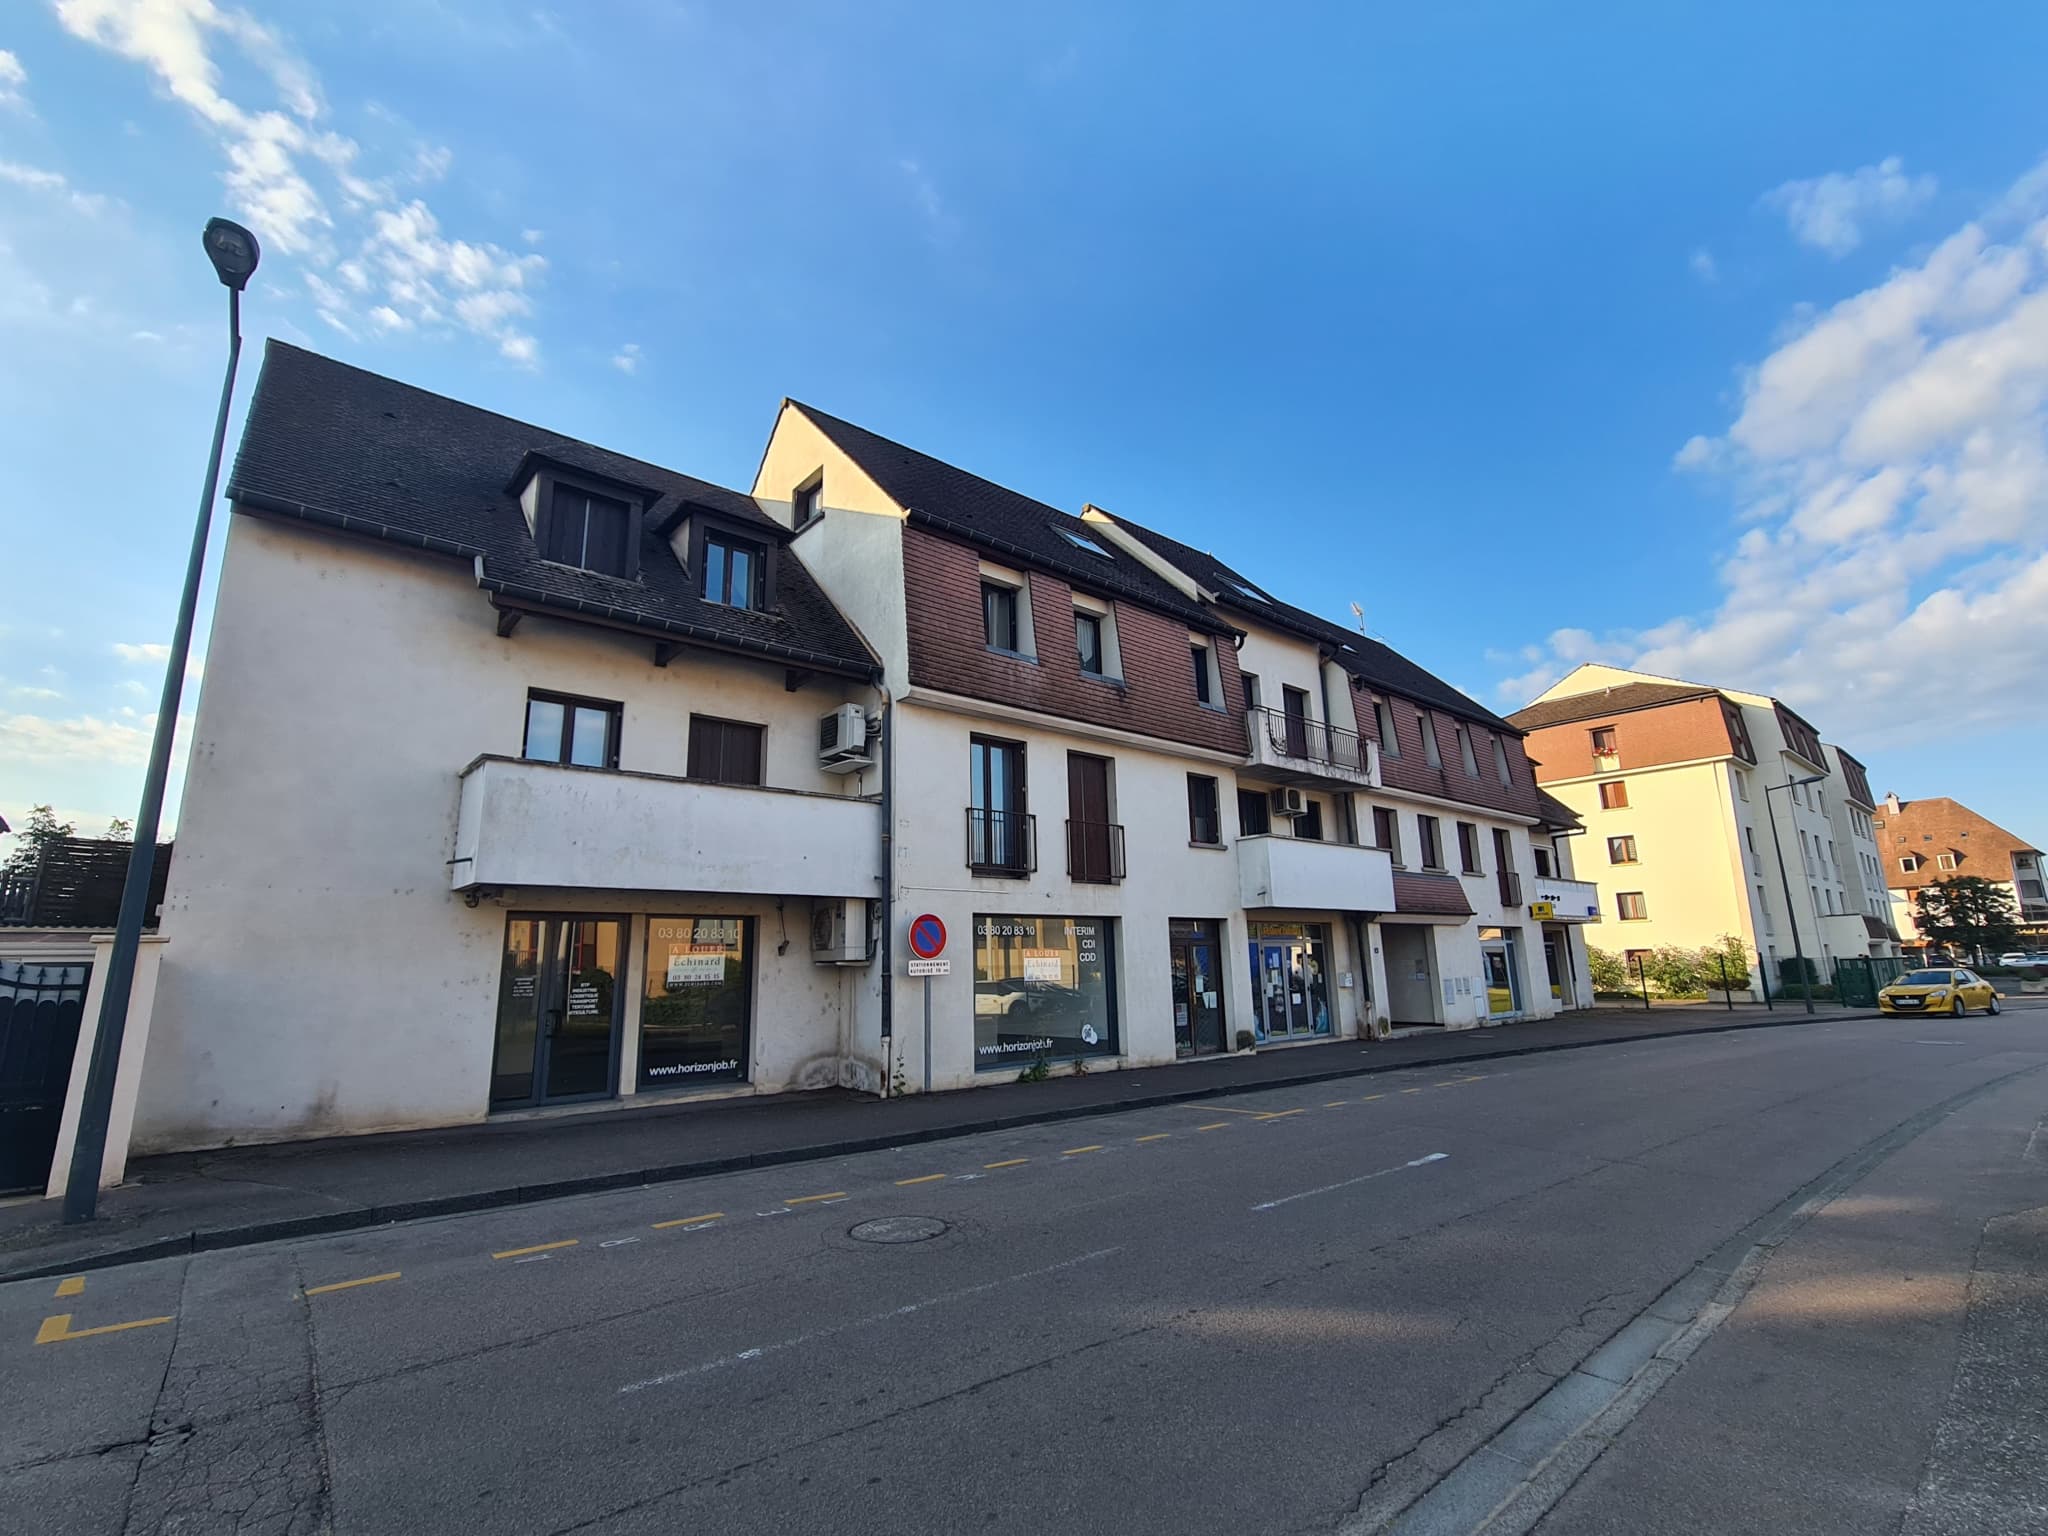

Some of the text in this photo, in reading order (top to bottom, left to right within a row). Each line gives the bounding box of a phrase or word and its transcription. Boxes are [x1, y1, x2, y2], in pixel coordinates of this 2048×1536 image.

[658, 927, 741, 939] 03 80 20 83 10
[978, 925, 987, 936] 03
[1002, 925, 1013, 936] 20
[1013, 925, 1024, 936] 83
[1025, 925, 1036, 936] 10
[1064, 926, 1095, 936] INTERIM
[1082, 939, 1096, 949] CDI
[673, 956, 721, 967] Echinard
[1079, 952, 1097, 962] CDD
[649, 1059, 738, 1076] www.horizonjob.fr
